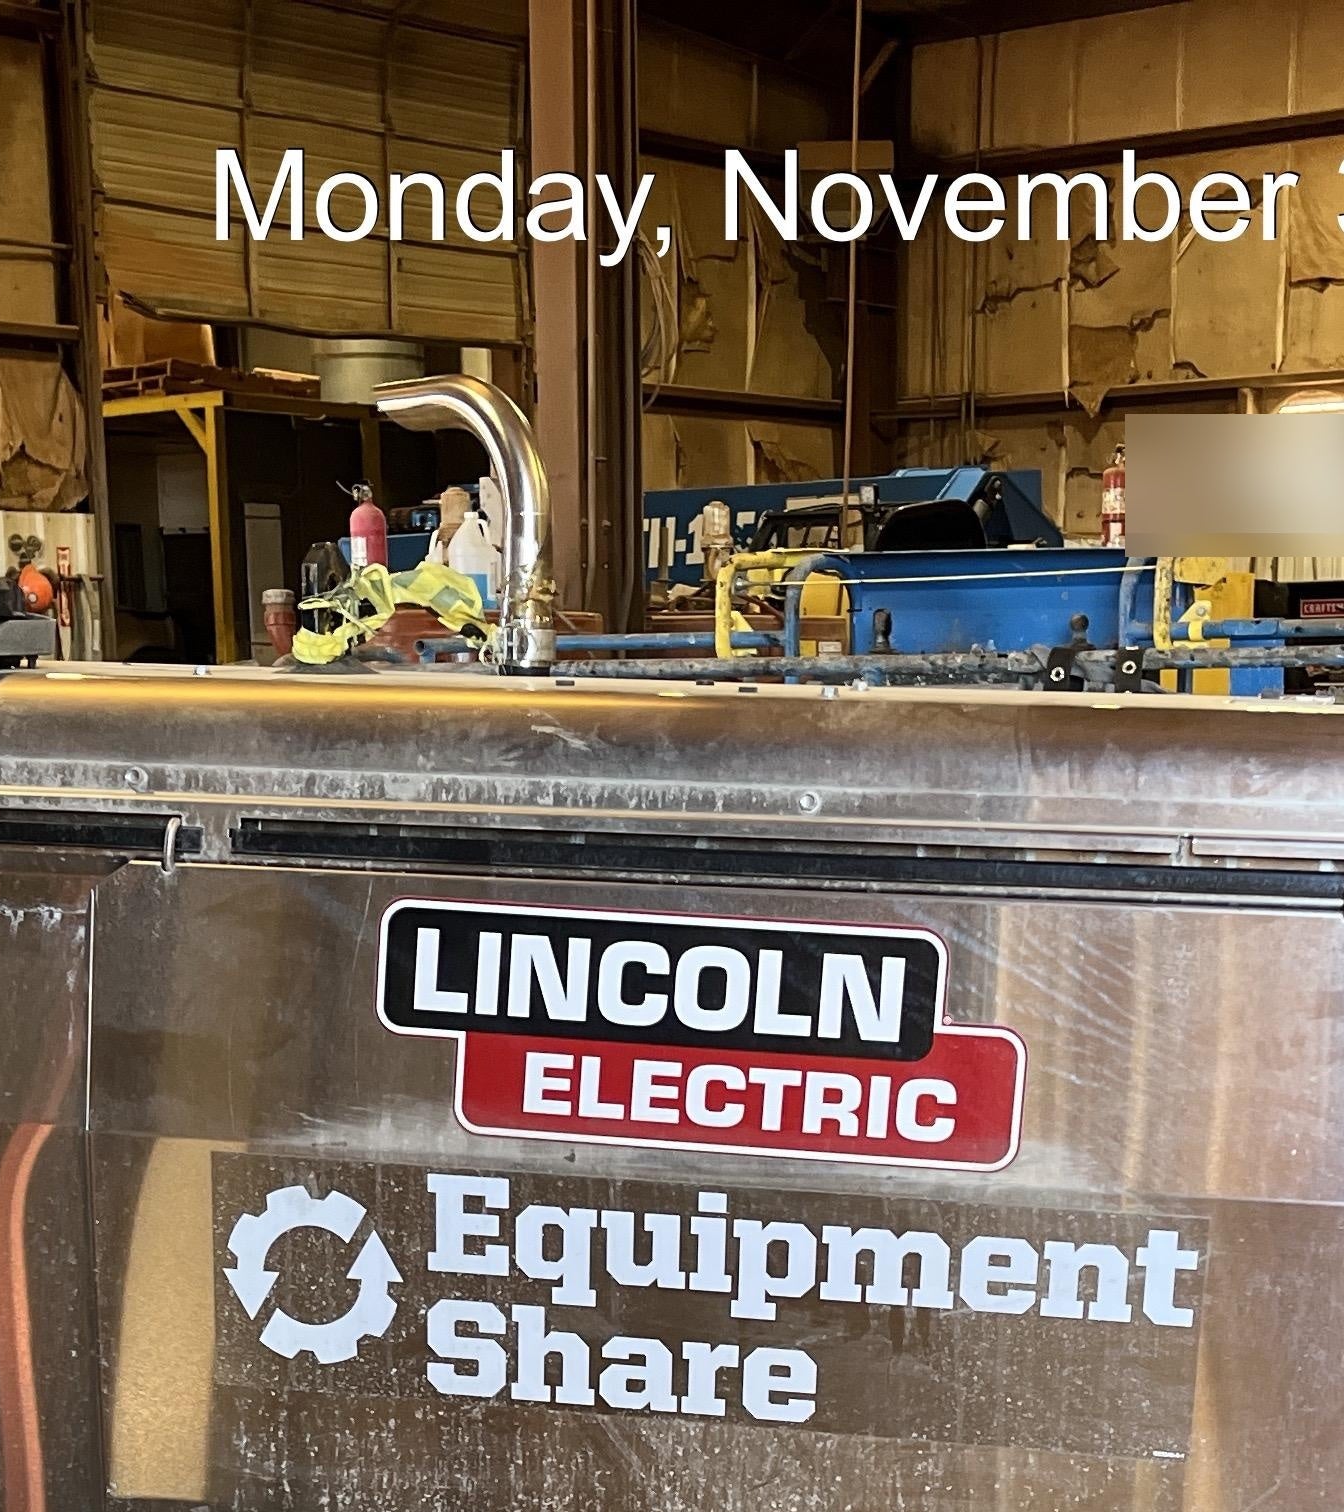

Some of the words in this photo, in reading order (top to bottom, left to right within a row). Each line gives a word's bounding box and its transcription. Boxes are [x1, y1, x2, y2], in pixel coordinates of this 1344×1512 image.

[412, 924, 908, 1045] LINCOLN
[522, 1051, 958, 1144] ELECTRIC
[426, 1172, 1198, 1328] Equipment
[426, 1300, 818, 1424] Share
